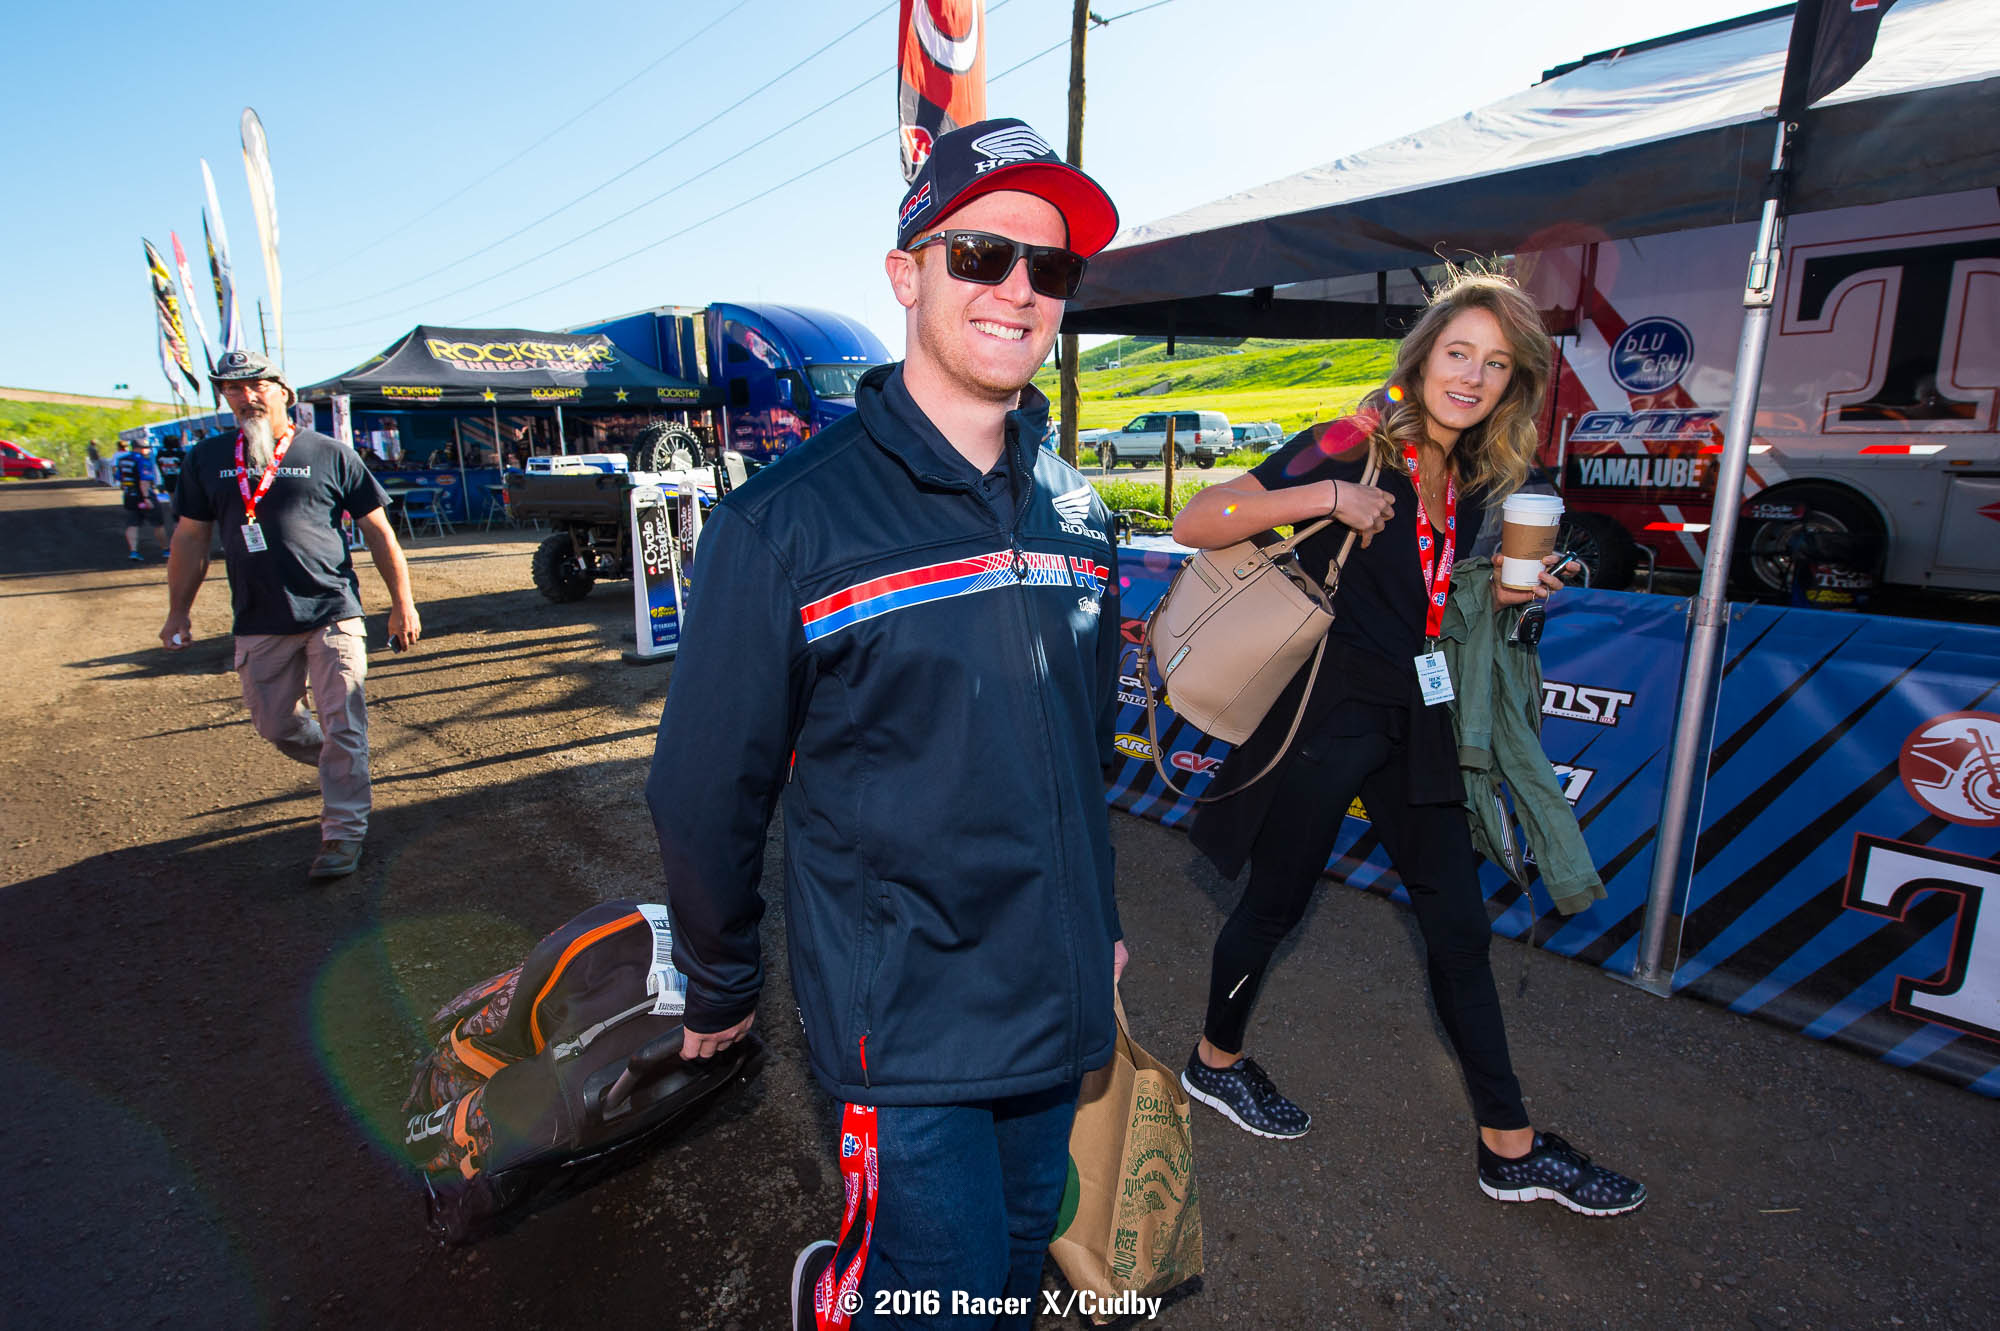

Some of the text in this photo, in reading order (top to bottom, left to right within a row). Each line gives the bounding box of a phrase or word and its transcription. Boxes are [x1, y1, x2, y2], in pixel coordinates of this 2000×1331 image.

[454, 359, 539, 371] ENERGY
[1579, 458, 1701, 488] YAMALUBE
[643, 521, 658, 565] Cycle
[1059, 521, 1109, 545] HONDA
[1114, 1237, 1137, 1252] RICE
